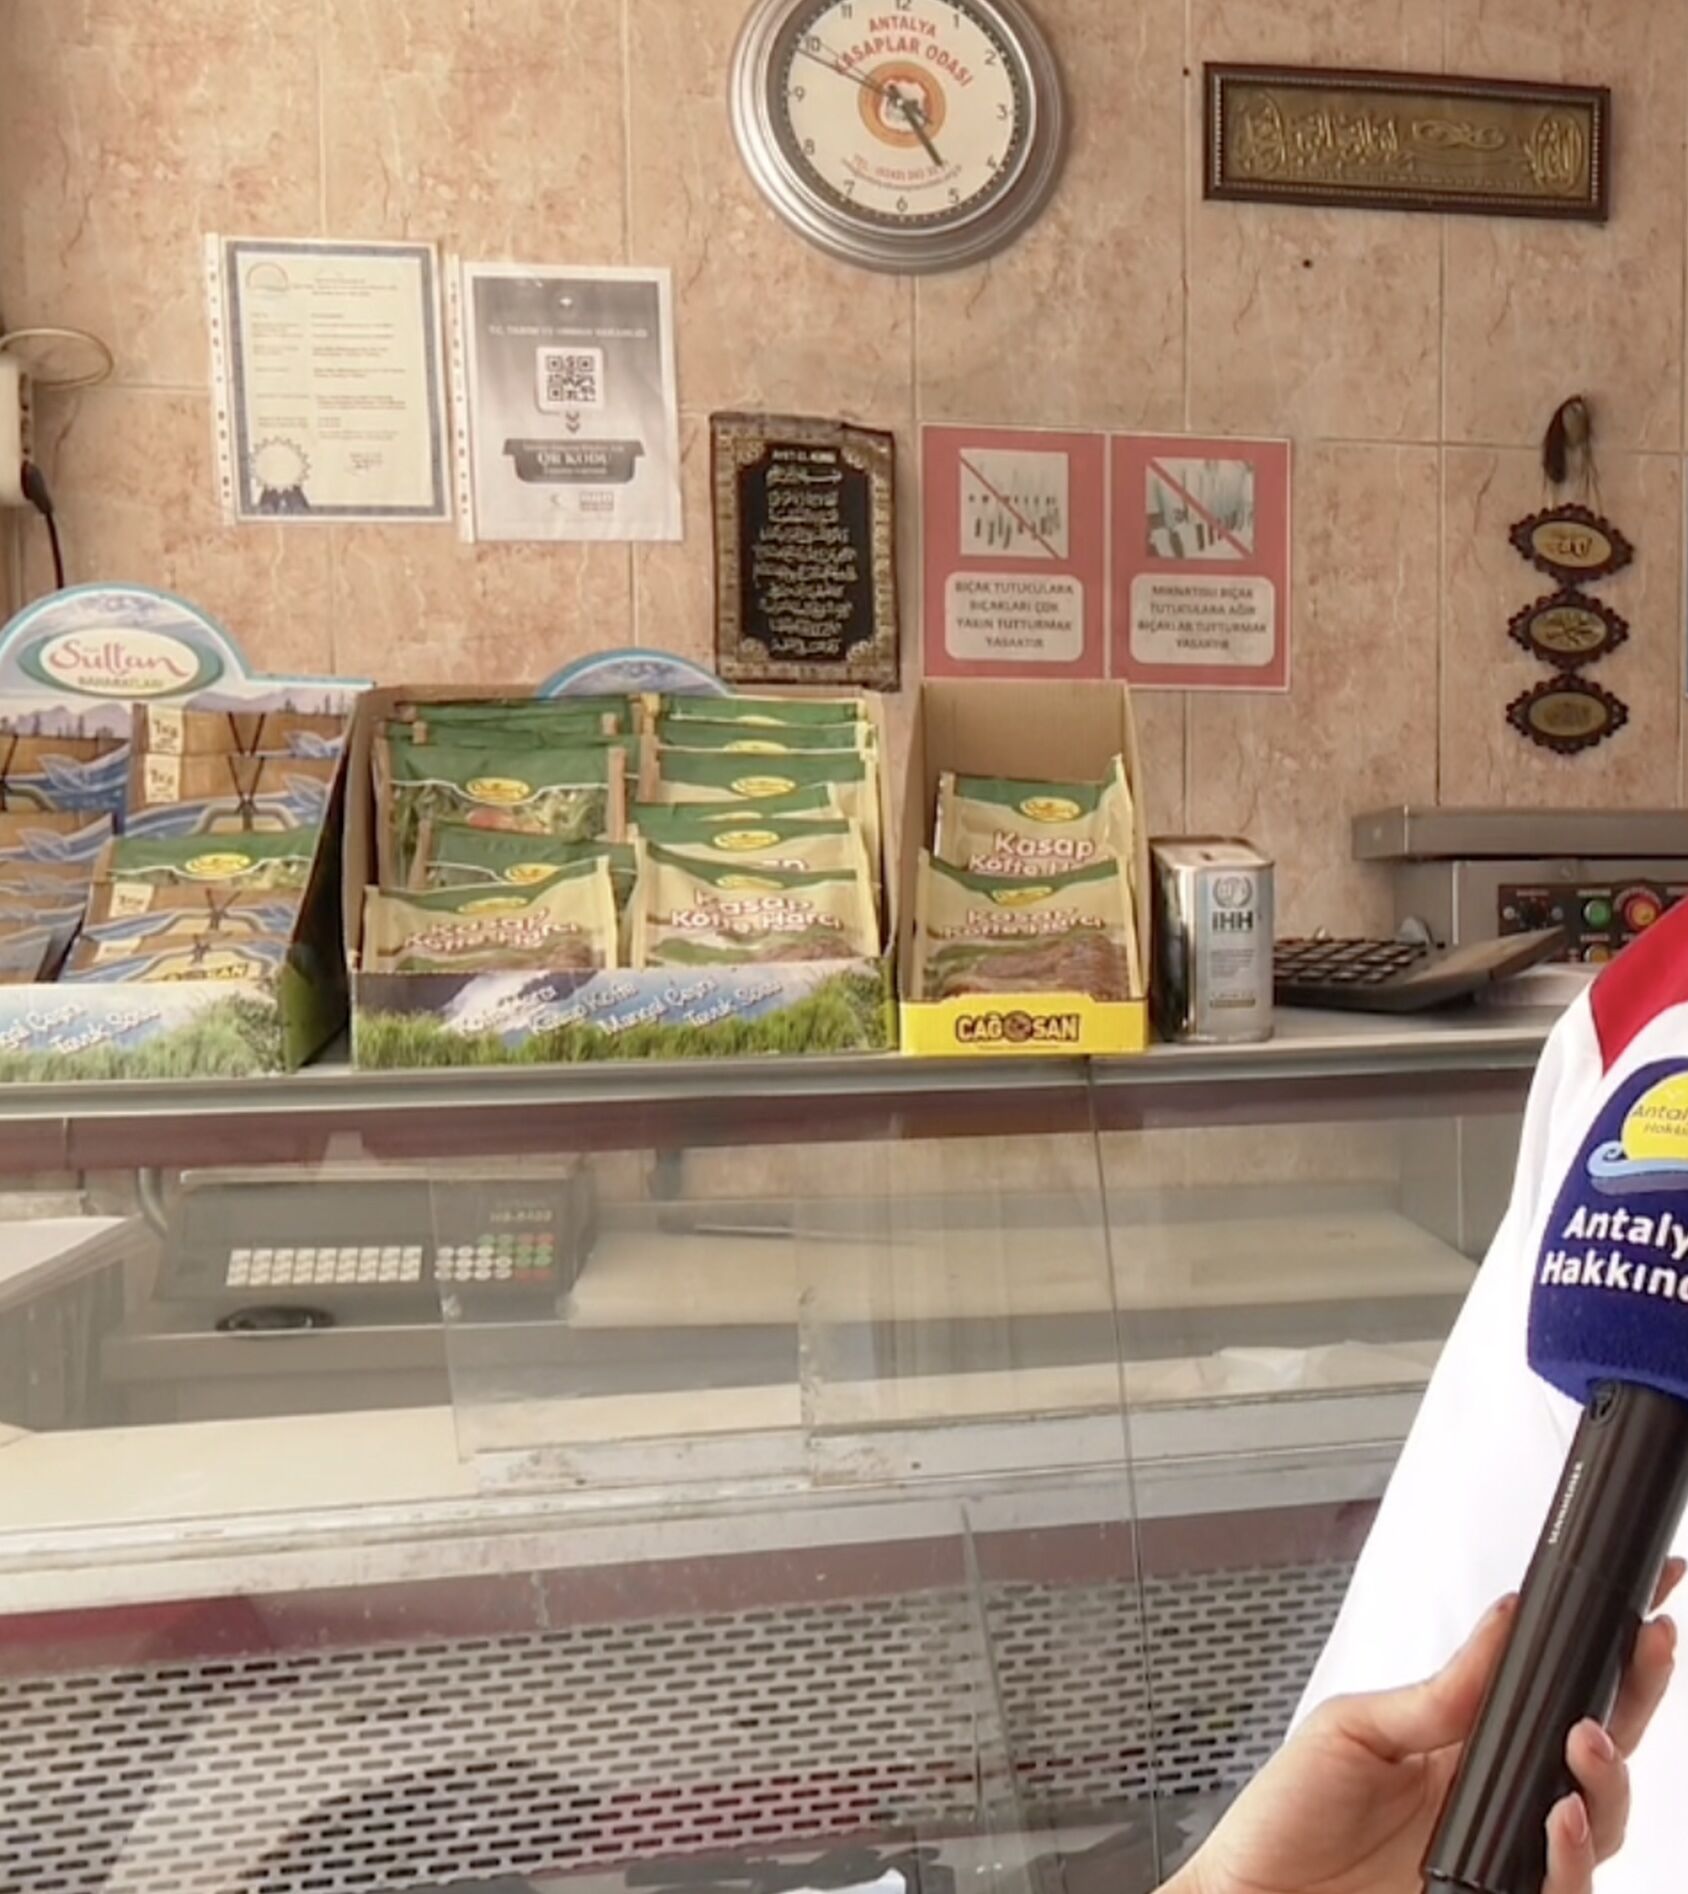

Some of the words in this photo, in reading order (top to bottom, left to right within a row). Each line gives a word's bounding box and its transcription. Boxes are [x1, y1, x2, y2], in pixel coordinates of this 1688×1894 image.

[869, 16, 936, 37] ANTALYA
[836, 37, 920, 75] KASAPLAR
[925, 44, 973, 86] ODASI
[993, 830, 1096, 861] Kasap
[1211, 910, 1253, 930] IHH
